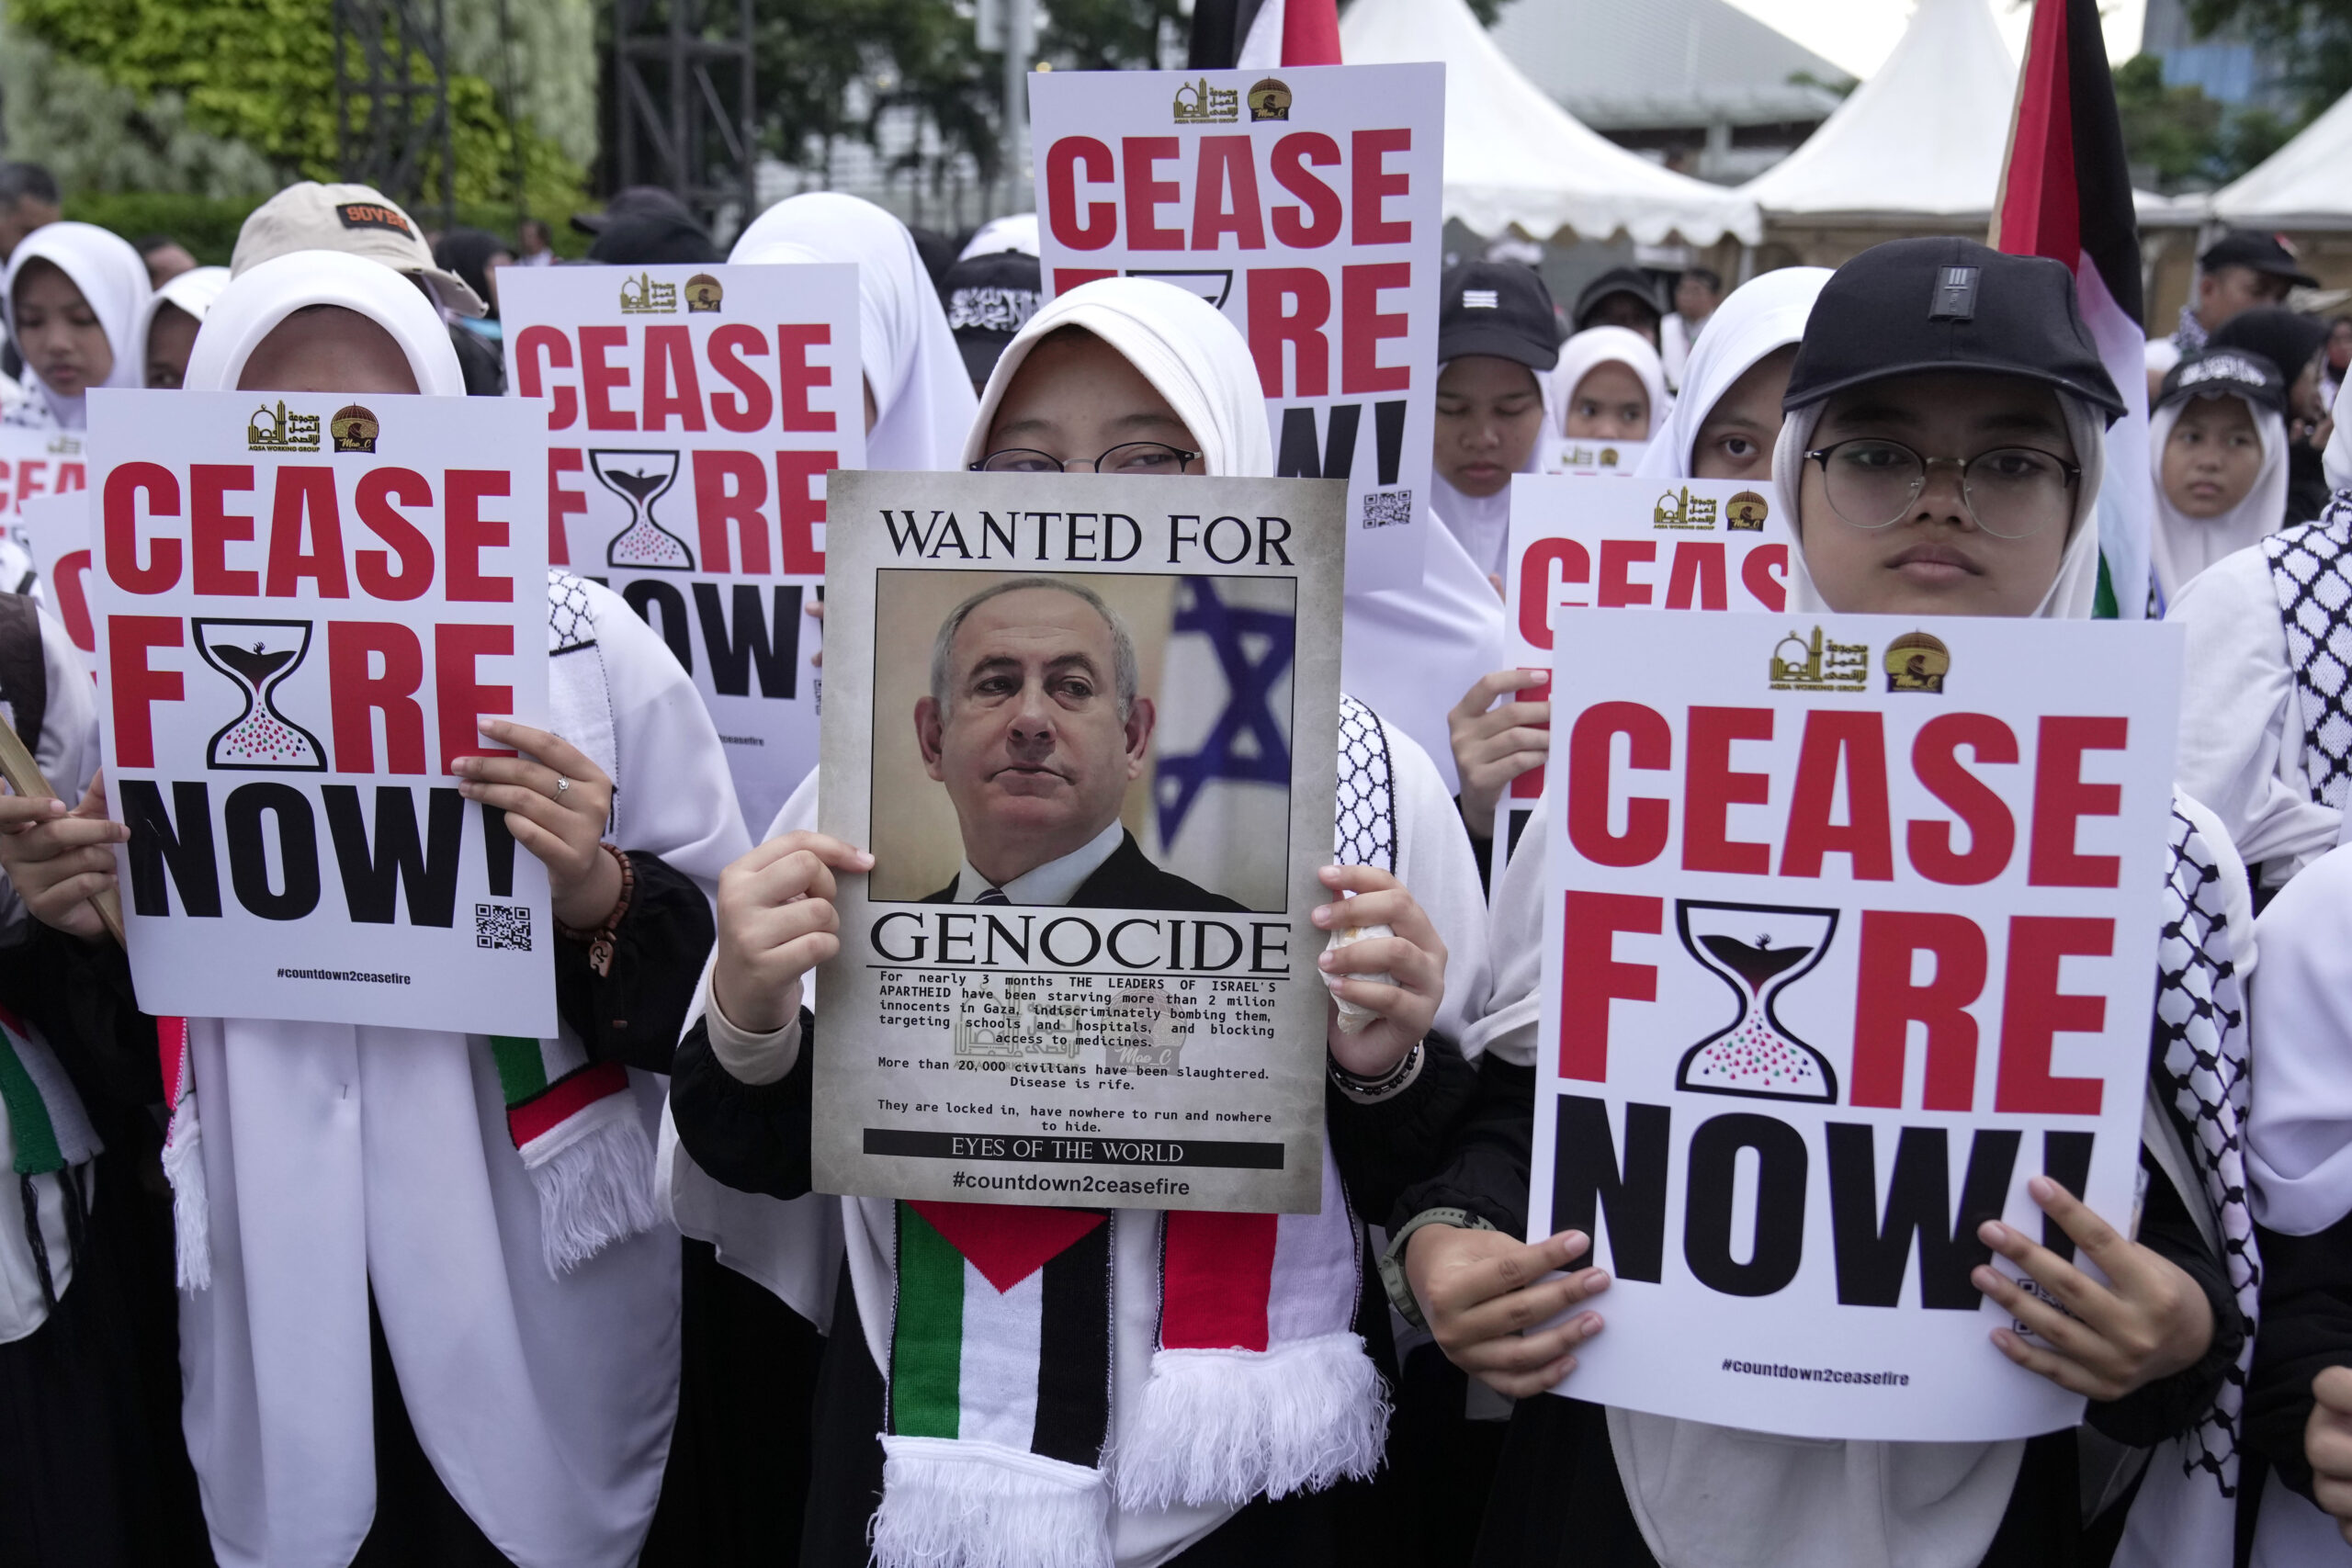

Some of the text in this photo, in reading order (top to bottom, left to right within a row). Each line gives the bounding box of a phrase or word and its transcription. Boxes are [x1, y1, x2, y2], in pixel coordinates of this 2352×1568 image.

[1046, 129, 1412, 251] CEASE
[515, 323, 837, 433] CEASE
[104, 462, 514, 603] CEASE
[878, 509, 1295, 566] WANTED FOR
[1567, 701, 2129, 888] CEASE
[869, 911, 1291, 974] GENOCIDE
[277, 968, 411, 985] #countdown2ceasefire
[880, 971, 1276, 992] For nearly 3 months THE LEADERS OF ISRAEL'S
[879, 986, 1275, 1008] APARTHEID have been starving more than 2 milion
[880, 999, 1271, 1023] innocents in Gaza, indiscriminately bombing them,
[879, 1014, 1275, 1039] targeting schools and hospitals, and blocking
[995, 1034, 1152, 1047] access to medicines.
[878, 1056, 910, 1068] More
[918, 1058, 949, 1070] than
[958, 1060, 1006, 1073] 20,000
[1014, 1063, 1086, 1074] civilians
[1096, 1065, 1127, 1076] have
[1136, 1065, 1168, 1077] been
[1177, 1066, 1269, 1080] slaughtered.
[1011, 1077, 1135, 1090] Disease is rife.
[878, 1100, 1272, 1123] They are locked in, have nowhere to run and nowhere
[1042, 1122, 1102, 1133] to hide.
[952, 1137, 1183, 1162] EYES OF THE WORLD
[953, 1171, 1190, 1195] #countdown2ceasefire
[1722, 1359, 1909, 1386] #countdown2ceasefire
